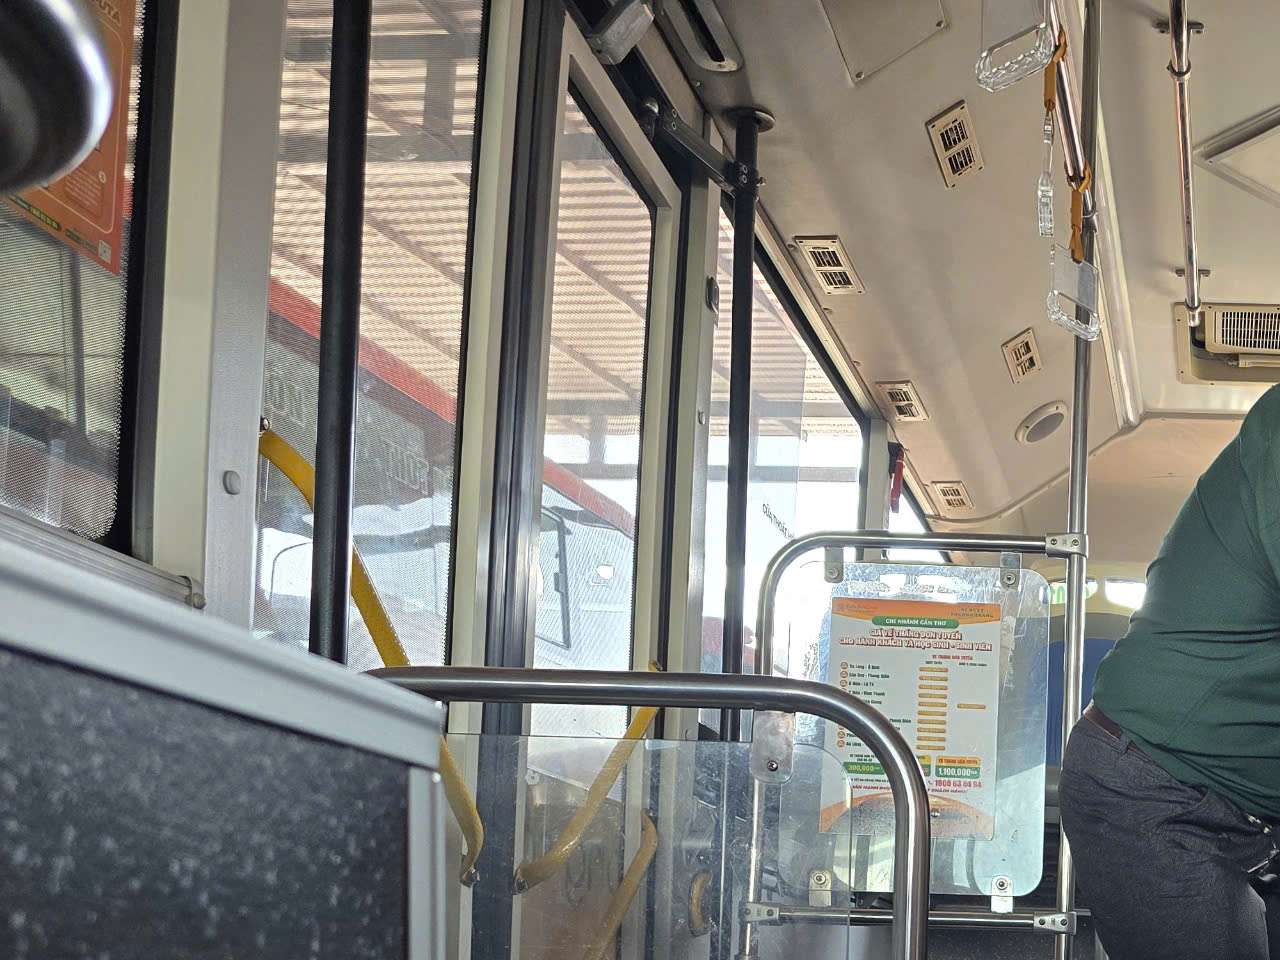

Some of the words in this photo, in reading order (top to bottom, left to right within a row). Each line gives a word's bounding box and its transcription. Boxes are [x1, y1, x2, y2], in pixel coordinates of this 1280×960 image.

[839, 637, 854, 646] CHO
[877, 637, 903, 648] KHÁCH
[915, 640, 930, 651] HỌC
[931, 641, 949, 650] SINH
[956, 641, 973, 651] SINH
